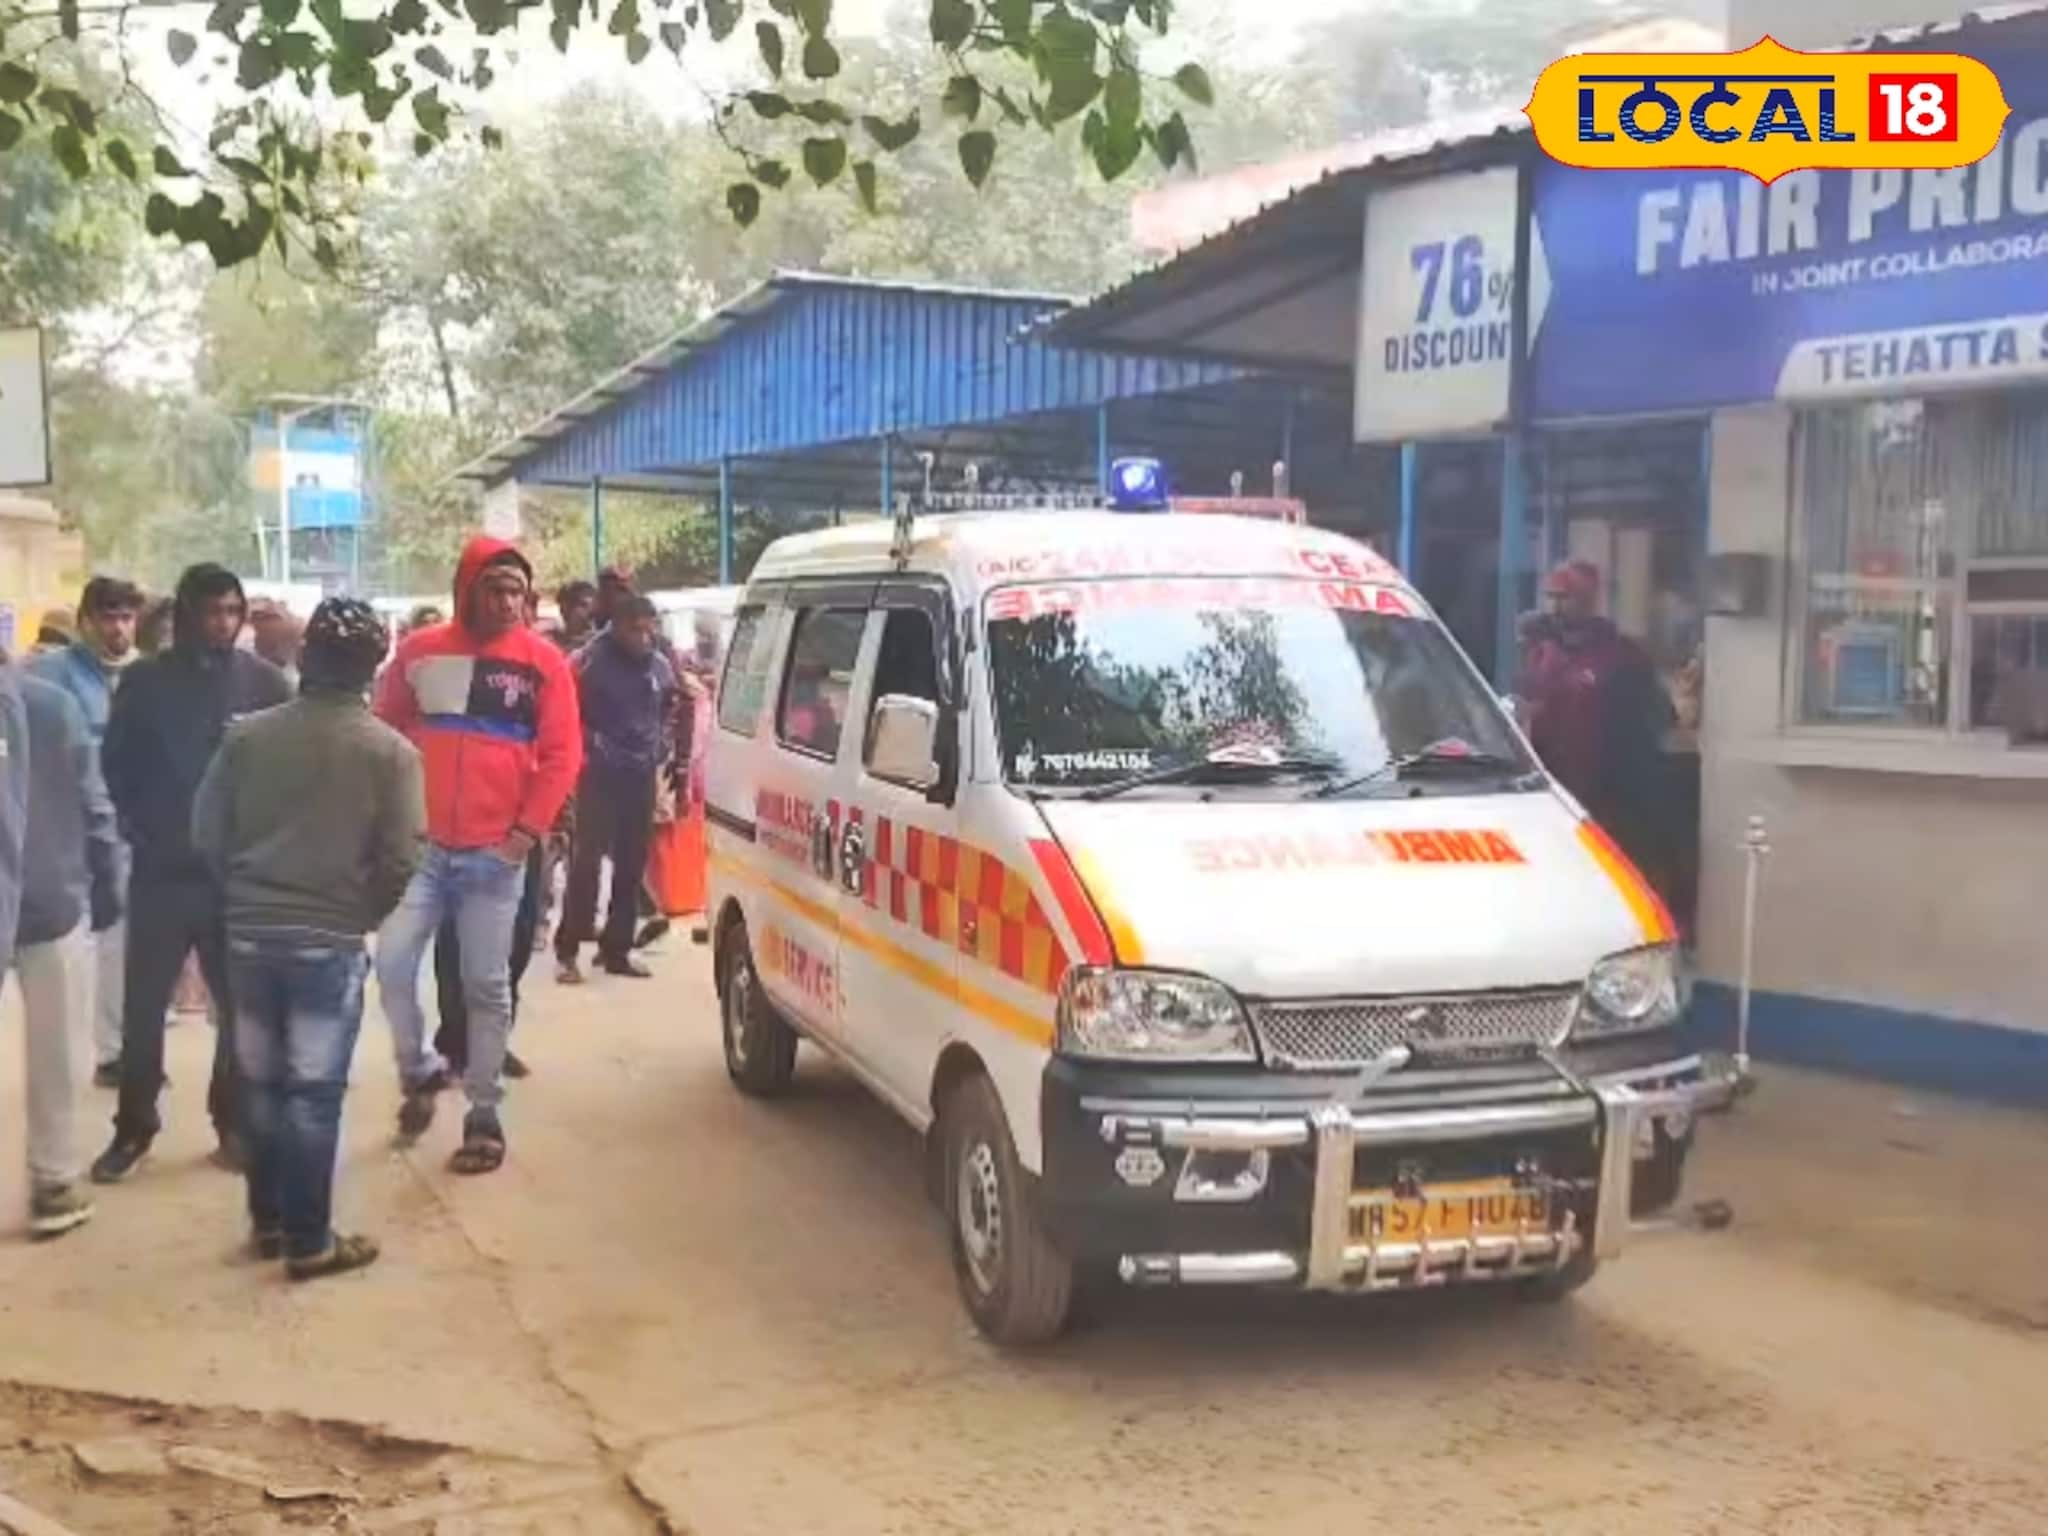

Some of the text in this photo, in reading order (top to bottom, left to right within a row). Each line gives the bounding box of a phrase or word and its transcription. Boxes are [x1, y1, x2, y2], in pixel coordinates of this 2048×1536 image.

[1636, 119, 2048, 275] FAIR PRIC
[1752, 230, 2048, 296] IN JOINT COLLABORA
[1384, 322, 1510, 373] DISCOUN
[1815, 327, 2018, 384] TEHATTA
